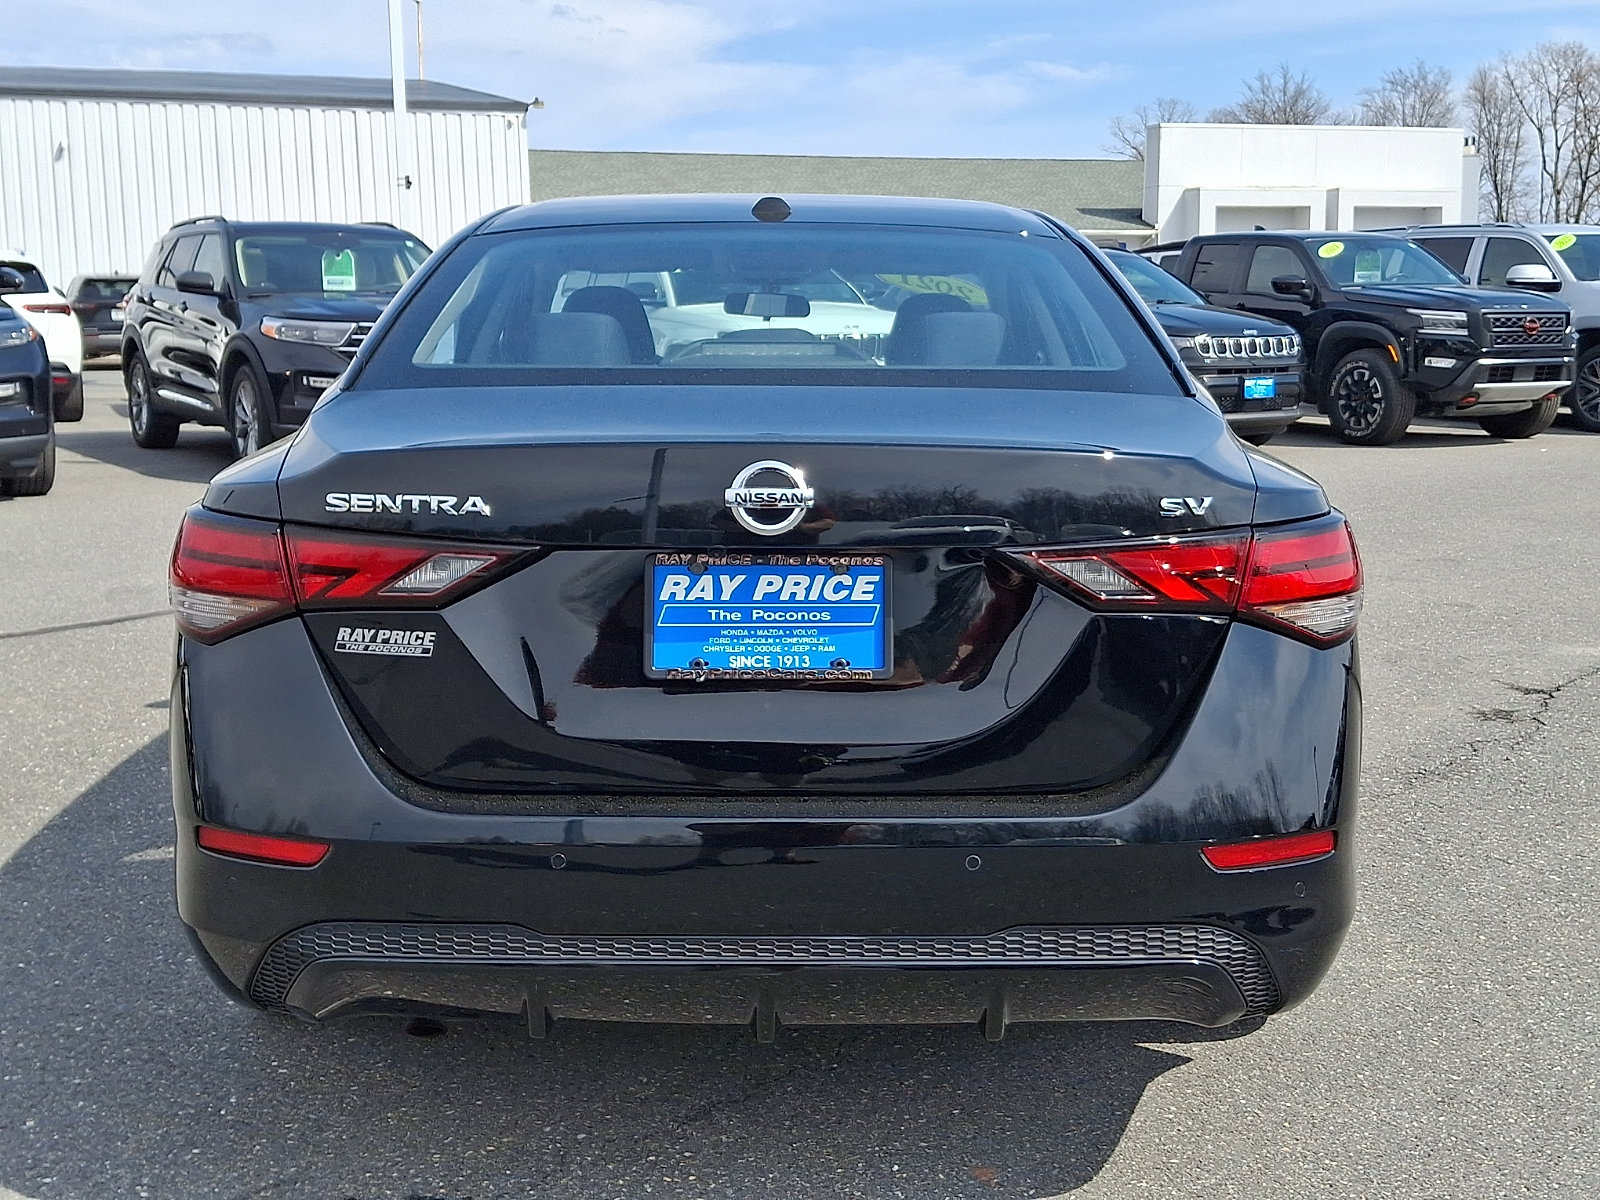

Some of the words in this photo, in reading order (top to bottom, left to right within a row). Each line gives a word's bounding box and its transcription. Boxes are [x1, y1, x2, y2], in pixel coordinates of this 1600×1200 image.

[325, 492, 491, 516] SENTRA
[734, 492, 803, 504] NISSAN
[1160, 496, 1213, 517] SV
[655, 553, 692, 566] RAY
[696, 553, 752, 566] PRICE
[767, 554, 801, 566] The
[805, 554, 884, 566] Poconos
[658, 574, 747, 601] RAY
[752, 574, 881, 602] PRICE
[708, 609, 742, 621] The
[752, 609, 832, 621] Poconos
[336, 627, 377, 643] RAY
[376, 629, 437, 646] PRICE
[345, 643, 365, 651] THE
[368, 645, 422, 654] POCONOS
[703, 645, 746, 653] CHRYSLER
[753, 645, 782, 653] DODGE
[790, 645, 811, 653] JEEP
[729, 655, 772, 668] SINCE
[777, 655, 811, 668] 1913
[666, 668, 873, 682] RayPriceCars.com
